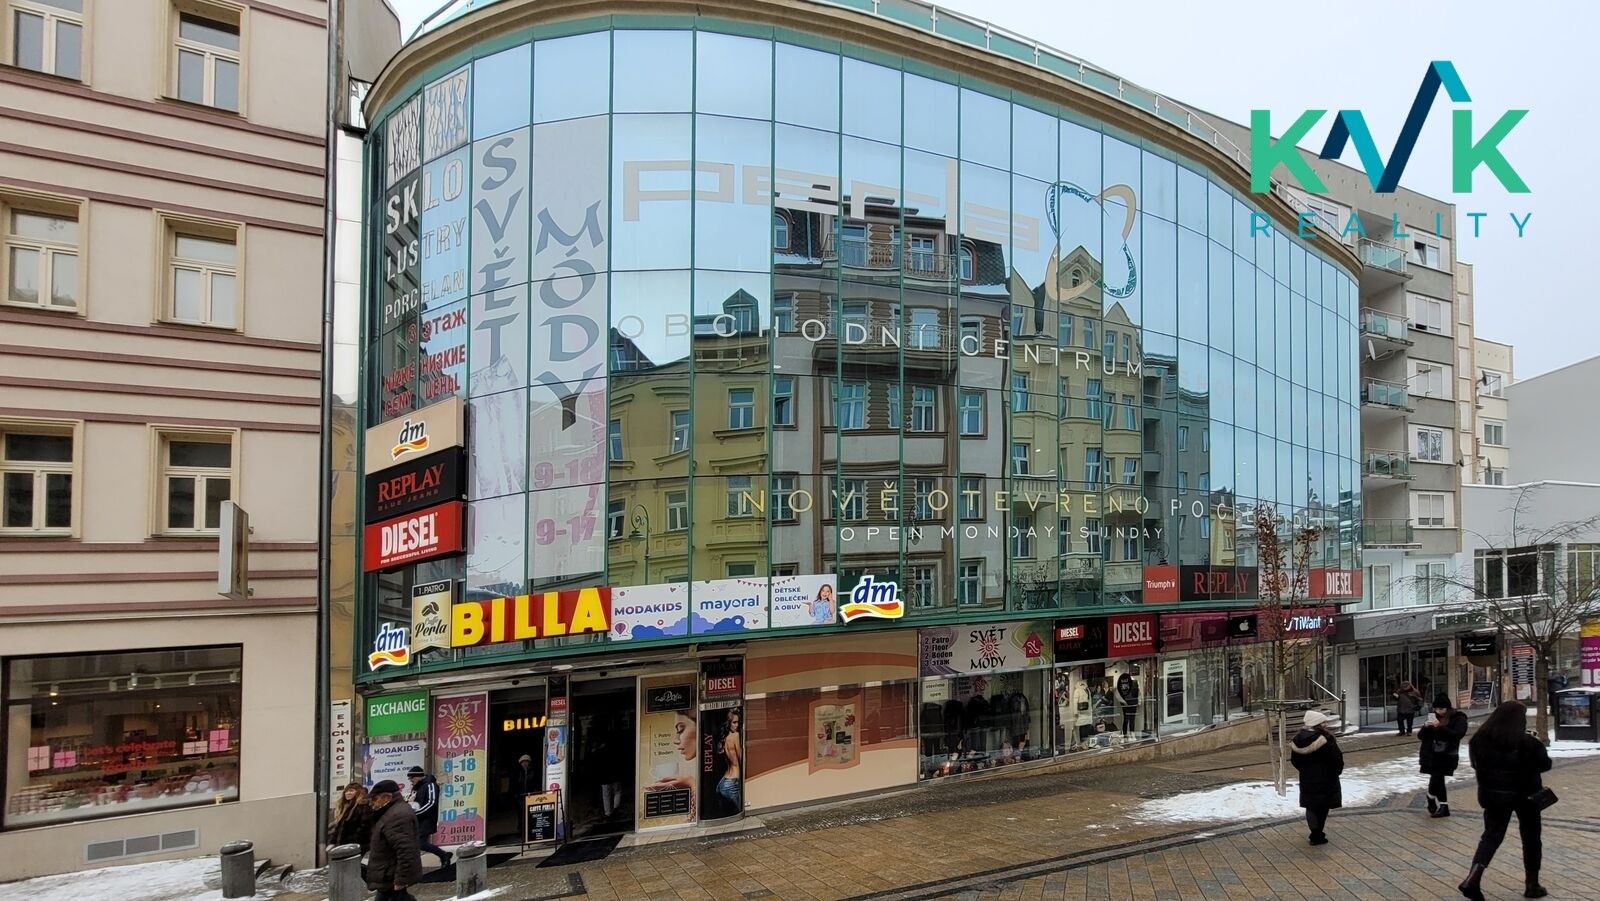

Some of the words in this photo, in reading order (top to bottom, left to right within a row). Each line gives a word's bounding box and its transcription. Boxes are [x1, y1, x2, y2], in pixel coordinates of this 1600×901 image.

[617, 313, 926, 351] OBCHODNÍ
[960, 336, 1142, 379] CENTRUM
[378, 463, 446, 503] REPLAY
[742, 481, 900, 513] NOVĚ
[927, 488, 1150, 514] OTEVŘENO
[381, 513, 439, 557] DIESEL
[840, 526, 922, 541] OPEN
[941, 526, 1055, 539] MONDAY
[1079, 526, 1163, 540] SUNDAY
[774, 586, 802, 594] DĚTSKÉ
[853, 577, 896, 604] dm
[1146, 580, 1171, 591] Triumph
[1193, 571, 1250, 595] REPLAY
[1326, 571, 1352, 595] DIESEL
[700, 594, 760, 612] mayoral
[774, 594, 809, 602] OBLEČENÍ
[451, 587, 610, 648] BILLA
[614, 602, 683, 616] MODAKIDS
[415, 619, 448, 638] Perla
[969, 626, 1007, 643] SVĚT
[1060, 627, 1079, 638] DIESEL
[1113, 621, 1152, 644] DIESEL
[375, 626, 405, 651] dm
[708, 677, 737, 691] DIESEL
[370, 699, 426, 717] EXCHANGE
[438, 698, 481, 717] SVĚT
[374, 744, 420, 755] MODAKIDS
[704, 733, 713, 773] REPLAY
[443, 758, 476, 773] 9-18
[454, 774, 465, 782] So
[444, 783, 475, 798] 9-17
